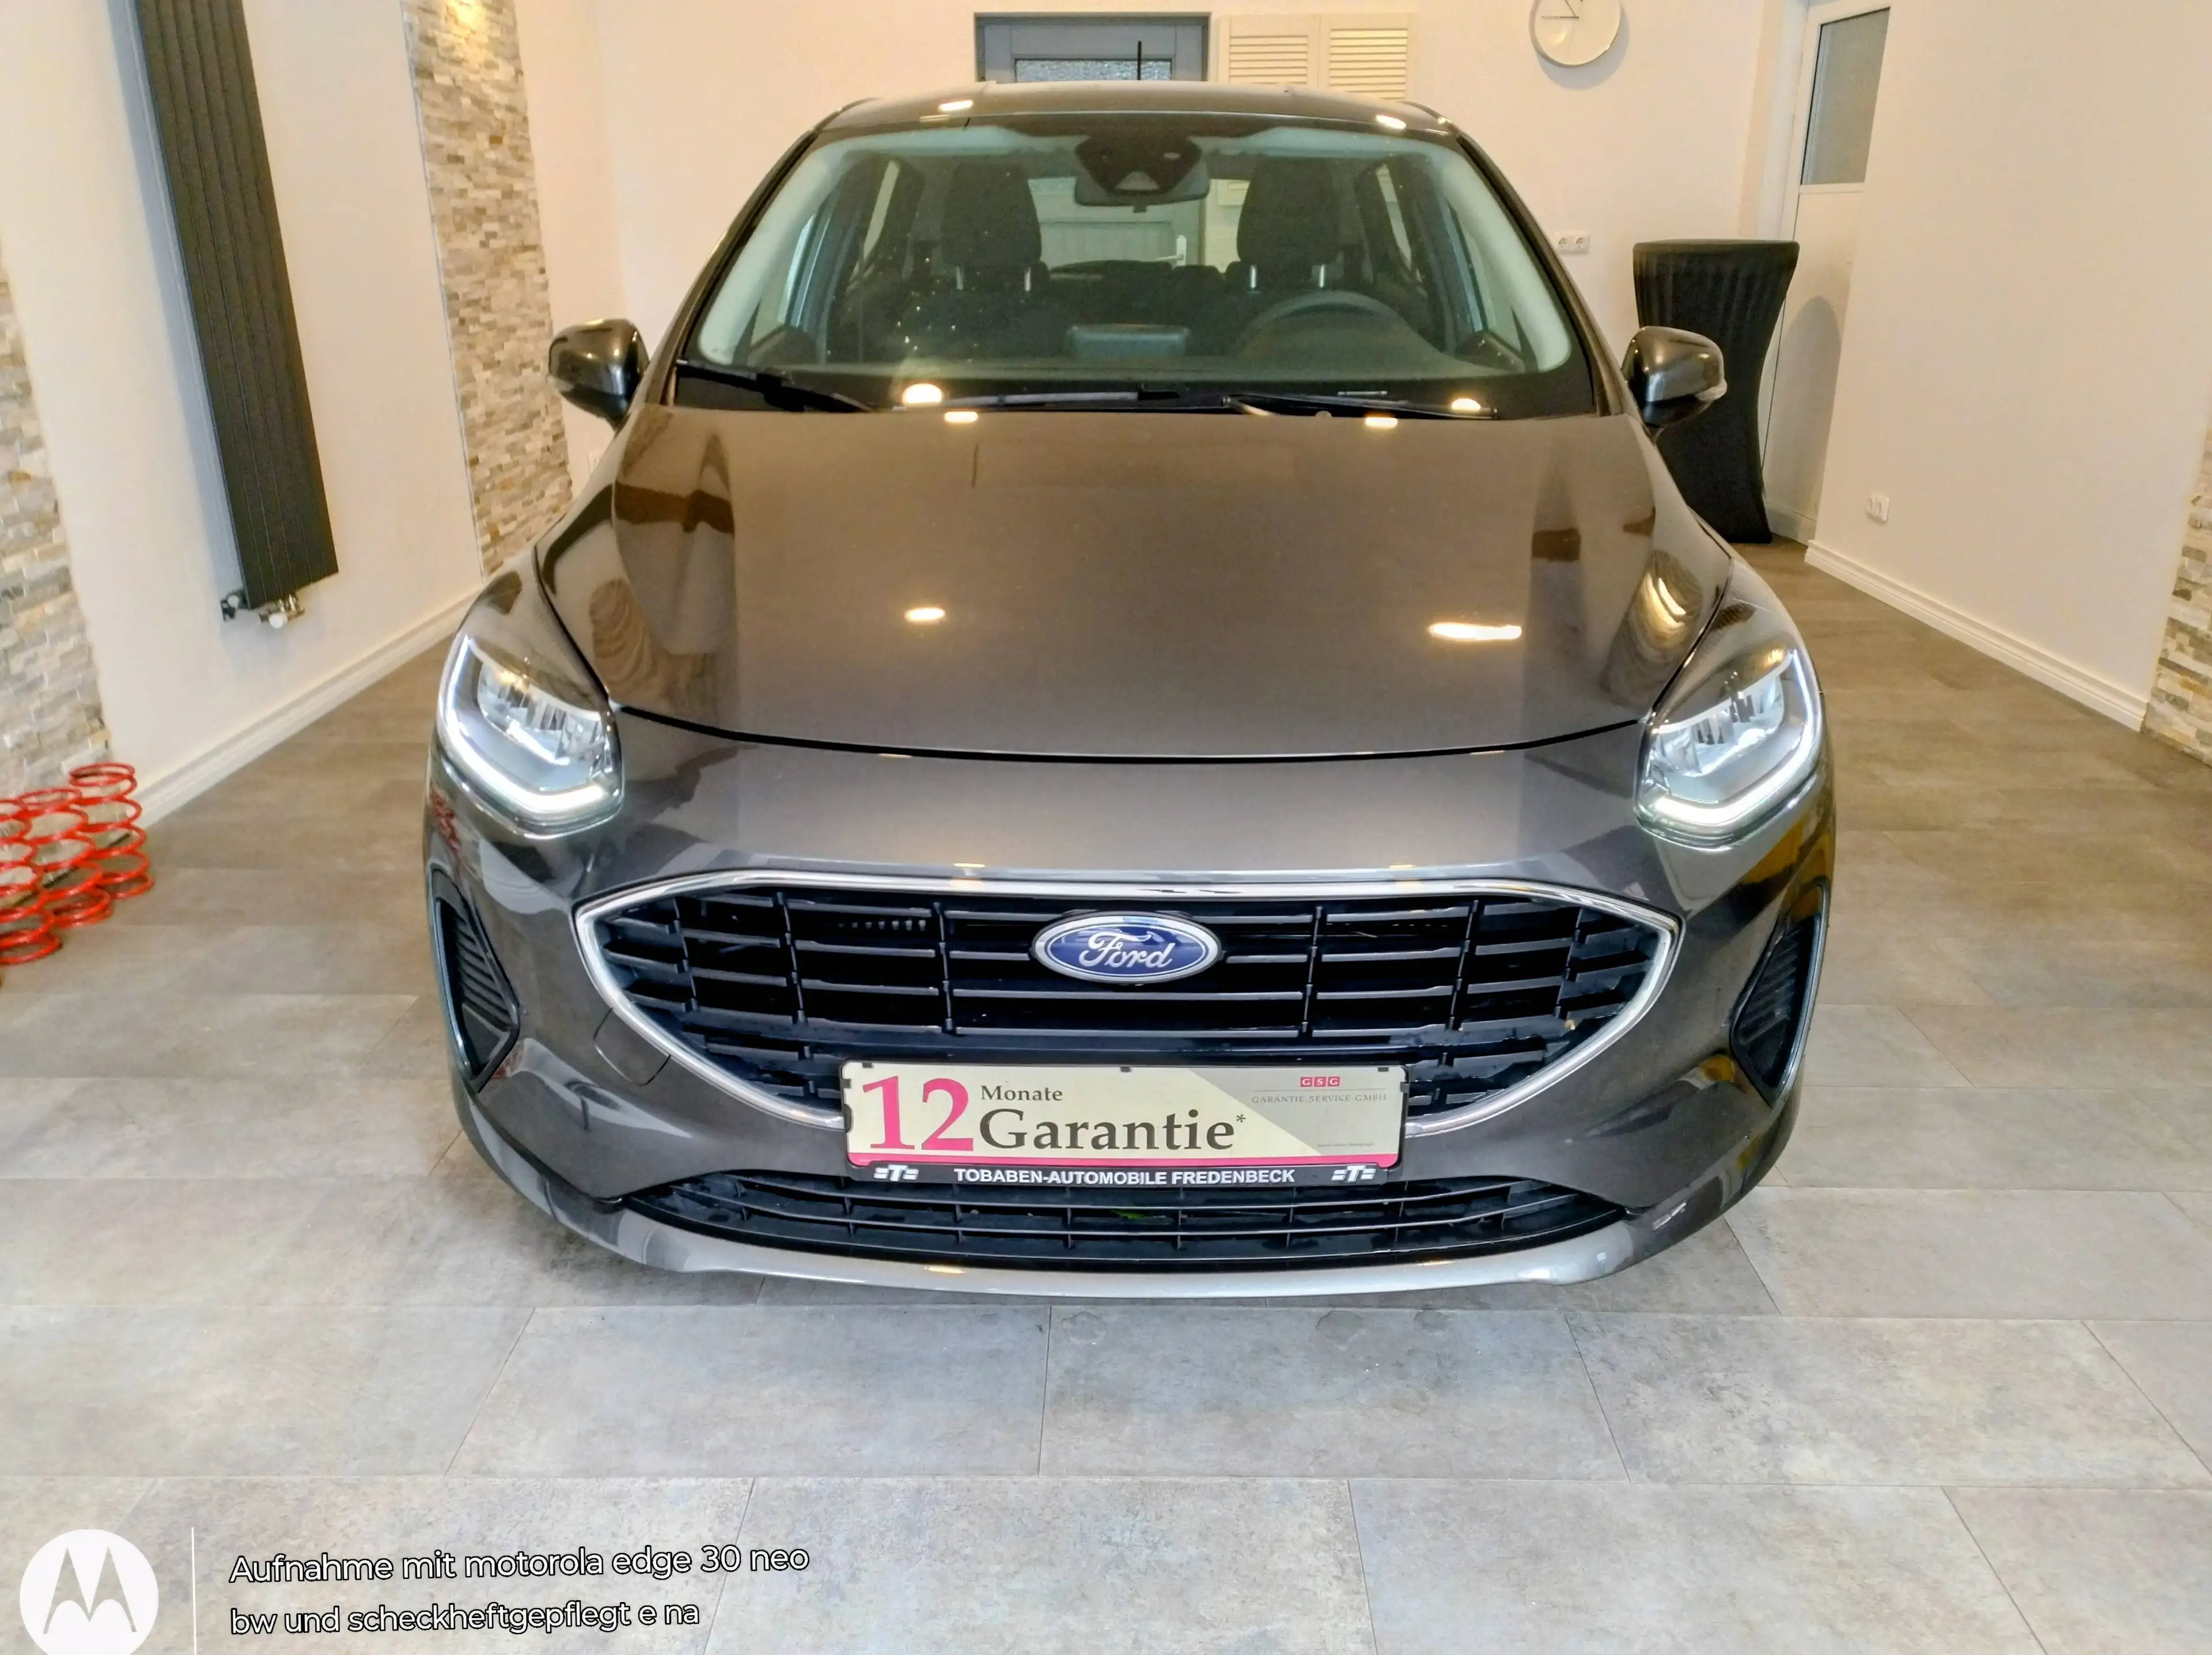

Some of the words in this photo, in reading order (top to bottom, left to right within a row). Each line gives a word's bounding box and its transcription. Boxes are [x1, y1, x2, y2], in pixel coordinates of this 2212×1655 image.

[1079, 931, 1176, 968] Ford
[1301, 1077, 1339, 1086] GSG
[862, 1075, 974, 1152] 12
[980, 1085, 1063, 1101] Monate
[954, 1168, 1167, 1185] TOBABEN-AUTOMOBILE
[1172, 1169, 1295, 1185] FREDENBECK
